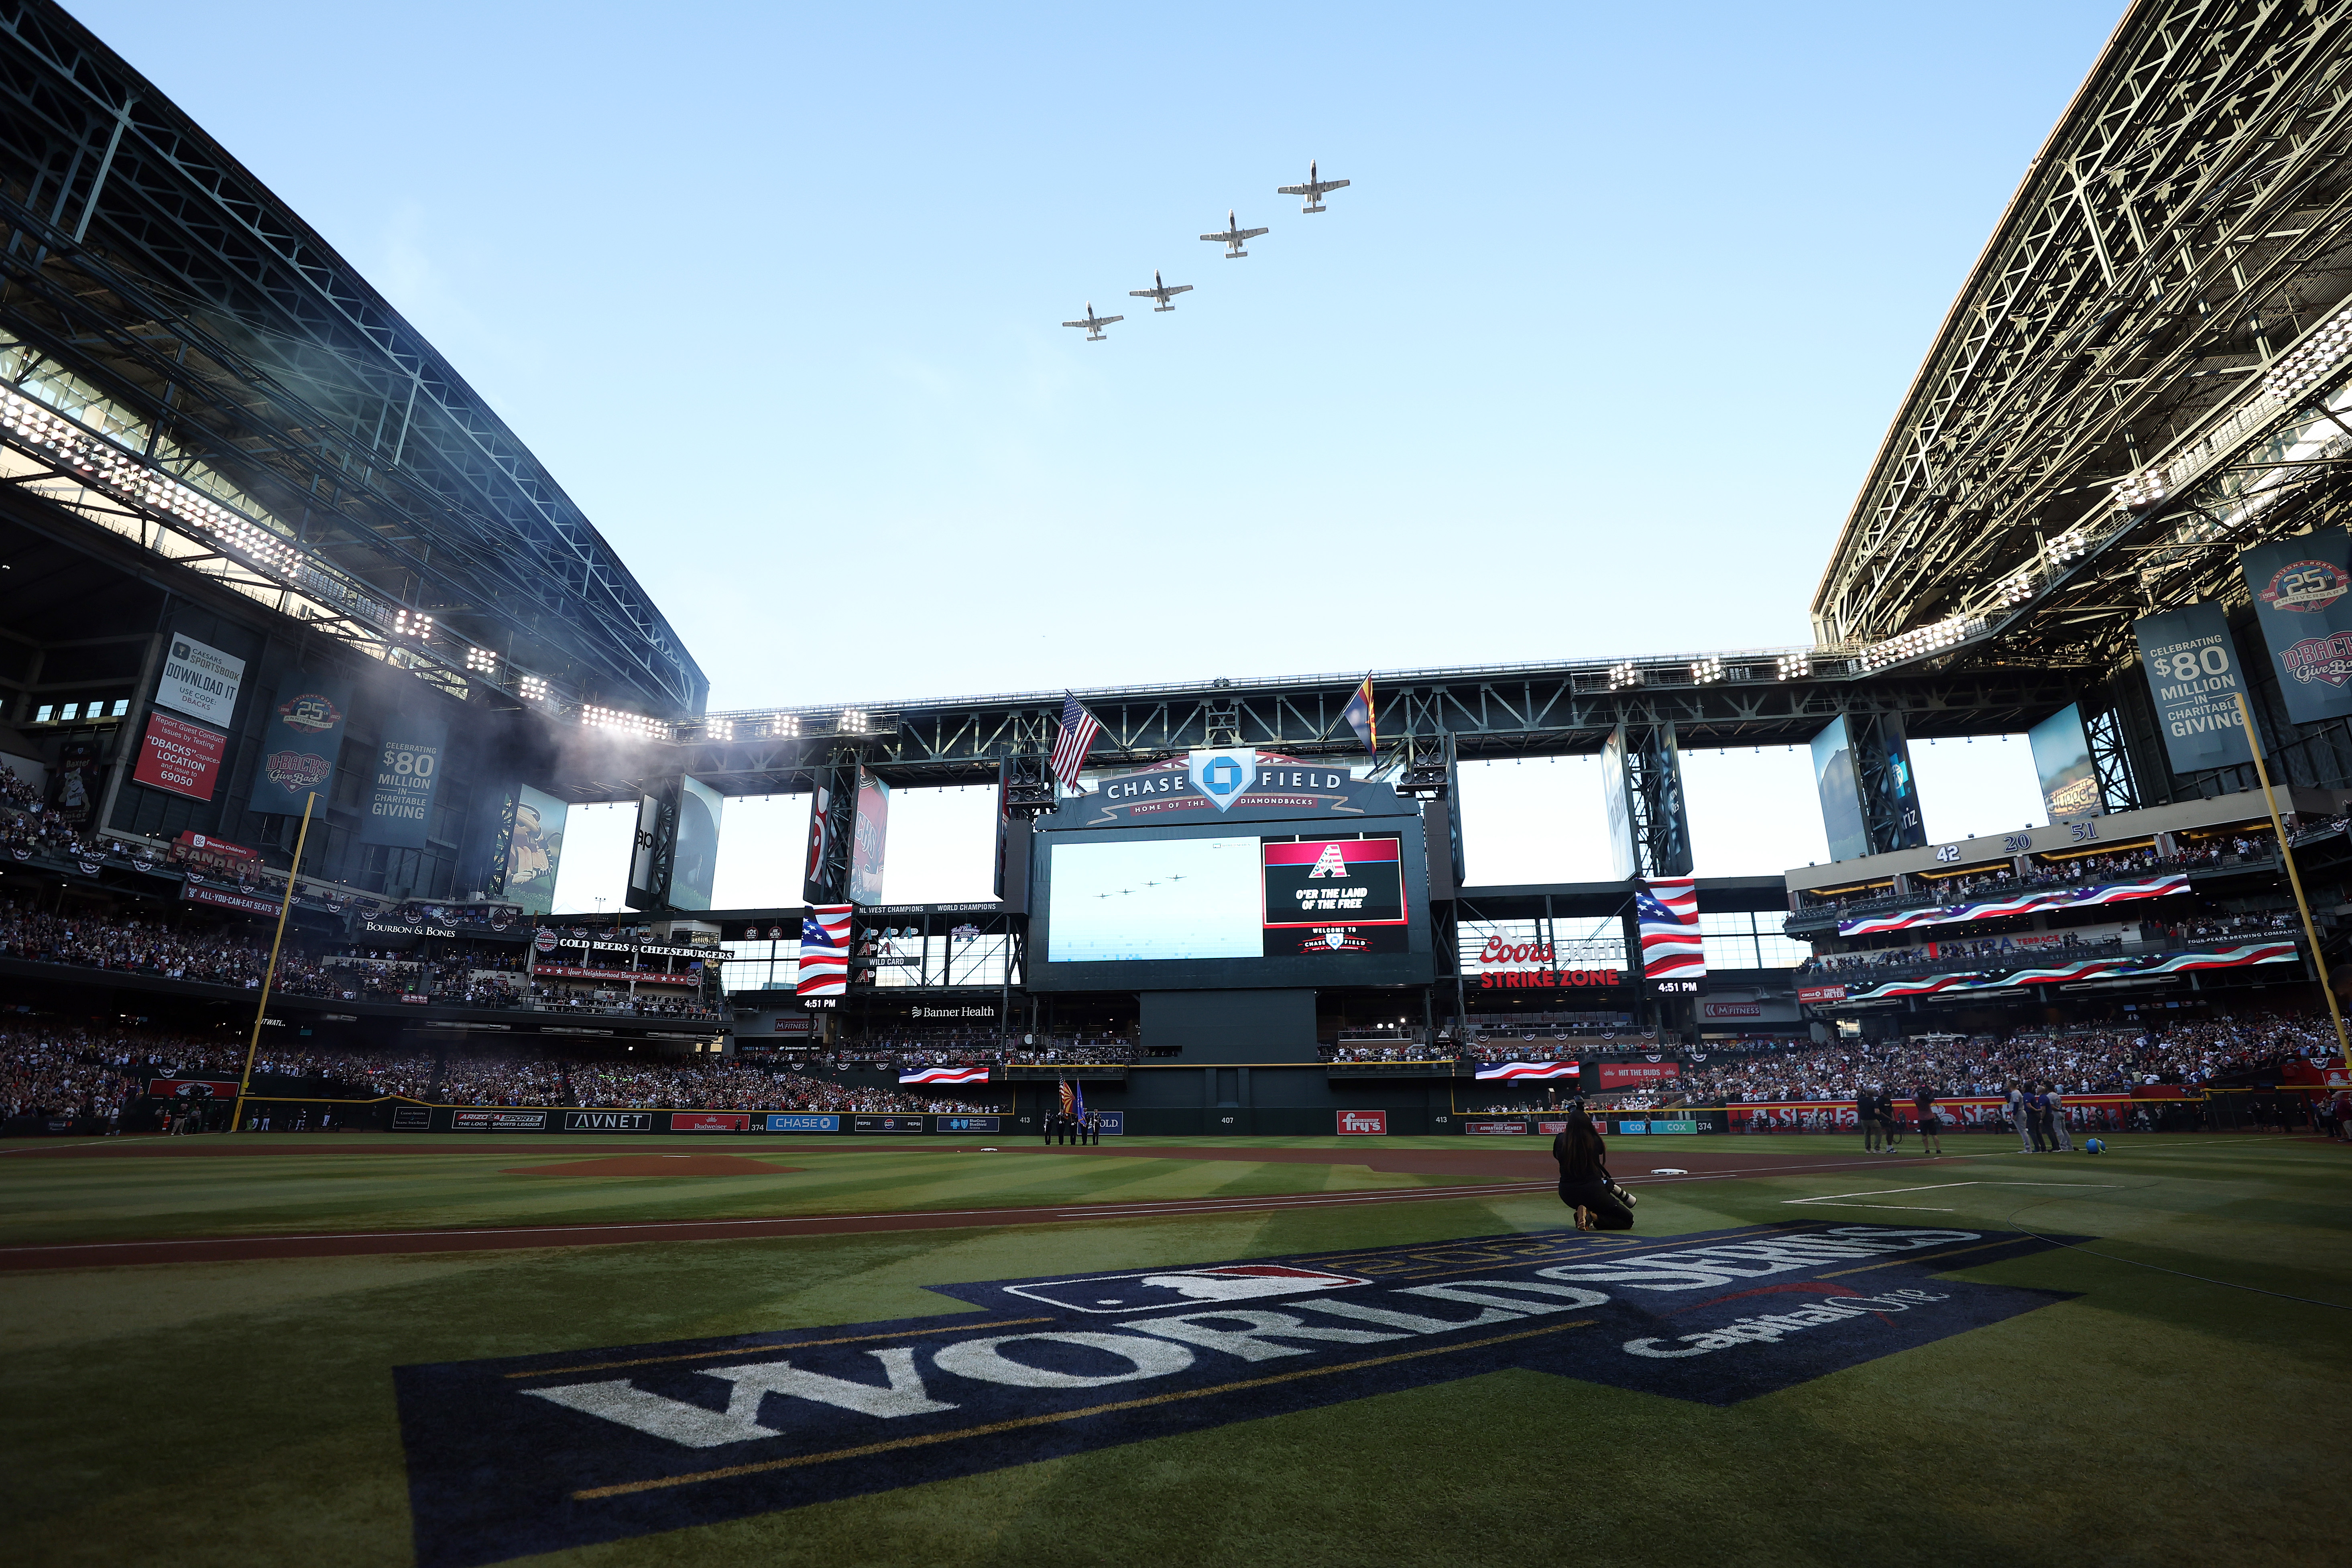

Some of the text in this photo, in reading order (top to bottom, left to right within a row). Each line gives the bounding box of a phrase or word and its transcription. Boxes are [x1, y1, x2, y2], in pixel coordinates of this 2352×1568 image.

[2273, 561, 2332, 583] ARIZONA BORN
[2276, 588, 2345, 606] ANNIVERSARY
[2150, 635, 2222, 657] CELEBRATING
[193, 649, 222, 664] CAESARS
[2154, 646, 2229, 681] $80
[190, 655, 240, 681] SPORTSBOOK
[2296, 665, 2330, 681] Give
[166, 662, 236, 700] DOWNLOAD IT
[2161, 674, 2236, 700] MILLION
[179, 687, 216, 705] USE CODE:
[182, 696, 211, 710] DBACKS
[293, 694, 333, 708] ARIZONA BORN
[2194, 694, 2208, 705] IN
[156, 716, 224, 743] Report Guest Conduct
[285, 716, 332, 727] ANNIVERSARY
[2171, 710, 2244, 737] GIVING
[162, 726, 214, 750] Issues by Texting
[386, 742, 437, 754] CELEBRATING
[66, 759, 90, 768] Baxter
[157, 750, 205, 772] LOCATION
[383, 750, 434, 777] $80
[161, 771, 193, 786] 69050
[174, 766, 189, 775] issue
[270, 769, 321, 783] Give Back
[378, 774, 431, 789] MILLION
[1107, 772, 1341, 799] CHASE FIELD
[2055, 780, 2089, 796] LOUISVILLE
[374, 794, 427, 806] CHARITABLE
[1135, 804, 1162, 813] HOME
[1240, 798, 1313, 806] DIAMONDBACKS
[372, 803, 425, 820] GIVING
[2070, 821, 2099, 842] 51
[207, 841, 247, 854] Phoenix Children's
[2003, 833, 2031, 853] 20
[1937, 845, 1961, 862] 42
[200, 891, 272, 912] ALL-YOU-CAN-EAT SEATS
[1296, 888, 1368, 899] O'ER THE LAND
[1302, 899, 1363, 910] OF THE FREE
[414, 925, 423, 935] &
[2016, 935, 2059, 945] TERRACE
[560, 939, 590, 948] COLD
[592, 942, 629, 951] BEERS
[641, 945, 732, 960] CHEESEBURGERS
[1480, 936, 1623, 963] Coors LIGHT
[568, 968, 581, 976] Your
[583, 969, 620, 978] Neighborhood
[621, 972, 640, 980] Burger
[1481, 969, 1619, 988] STRIKE ZONE
[1658, 982, 1697, 992] 4:51 PM
[924, 1006, 994, 1017] Banner Health
[575, 1114, 643, 1127] AVNET
[775, 1119, 818, 1128] CHASE
[1342, 1113, 1381, 1132] fry's
[1327, 1235, 1641, 1275] 2023
[519, 1226, 1981, 1447] WORLD SERIES
